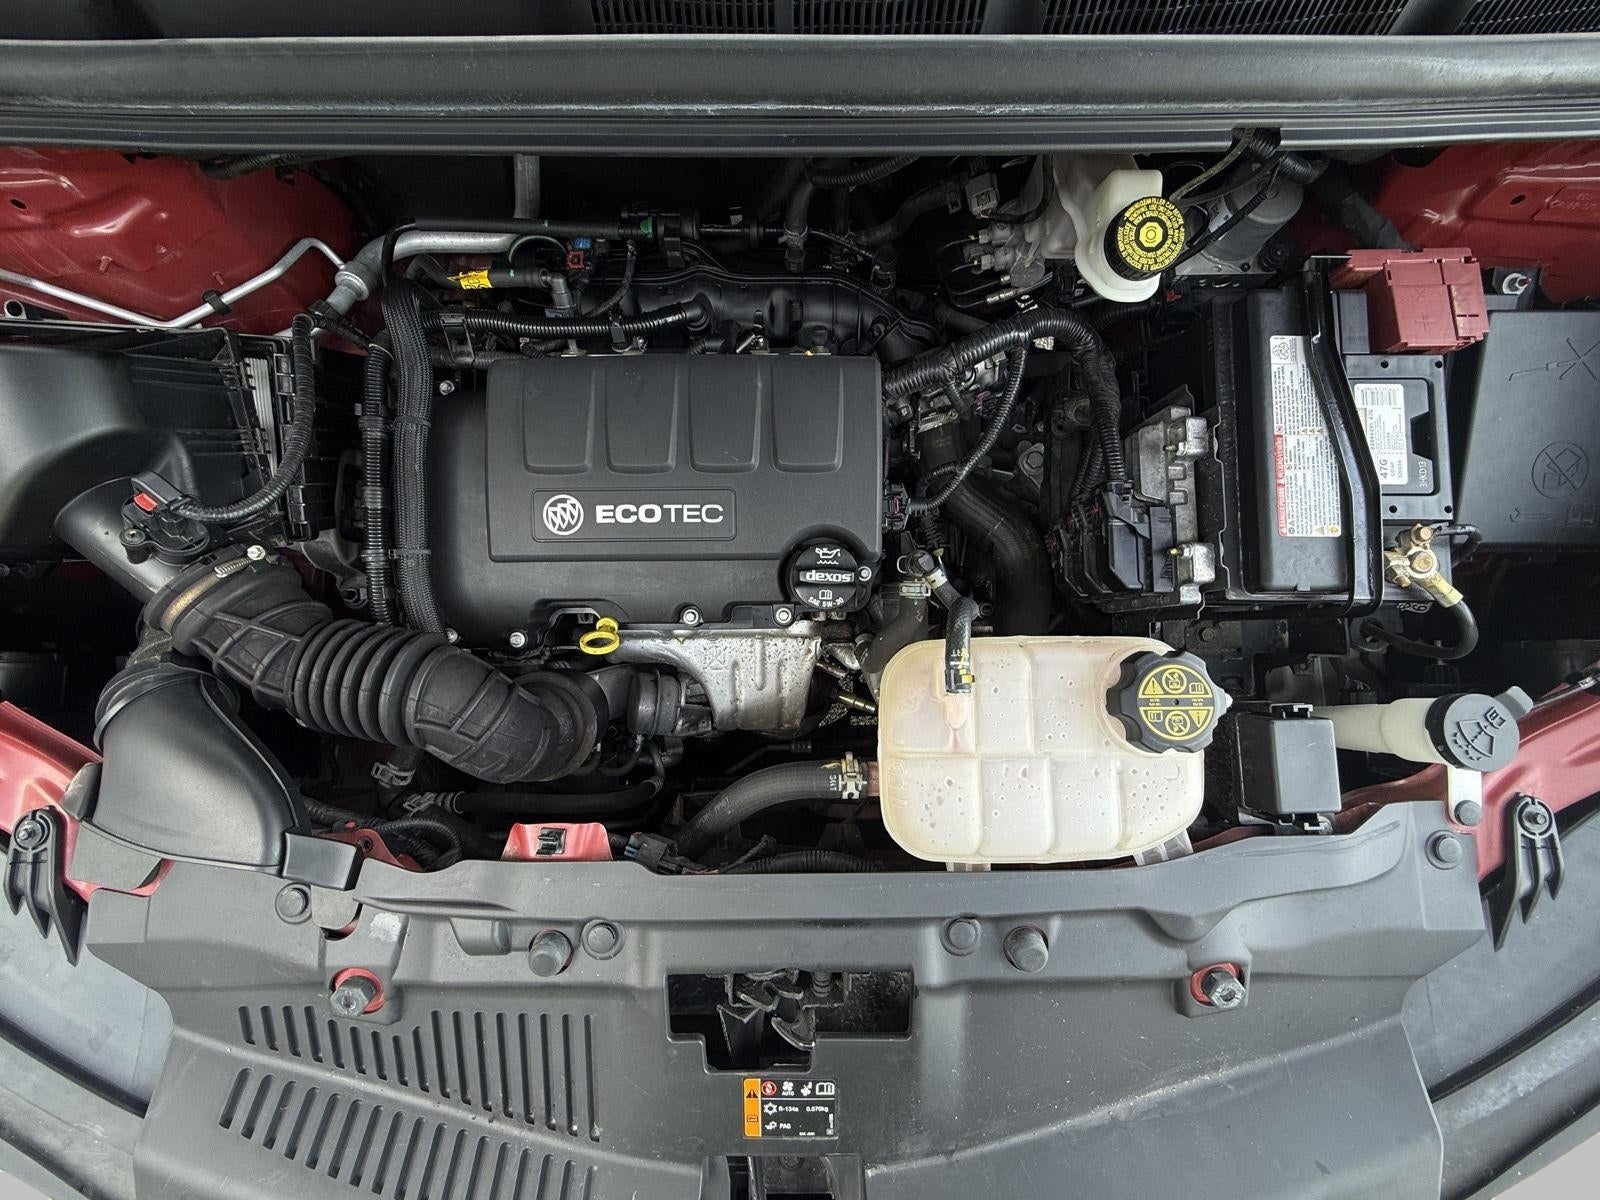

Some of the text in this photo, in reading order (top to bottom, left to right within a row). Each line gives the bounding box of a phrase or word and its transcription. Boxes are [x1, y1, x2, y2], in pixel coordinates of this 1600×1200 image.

[1152, 198, 1166, 206] FILLER
[1165, 202, 1175, 210] CAP
[1380, 459, 1388, 479] 47G
[596, 503, 724, 524] ECOTEC
[806, 570, 851, 582] dexos
[808, 596, 844, 608] SAE 5W-30
